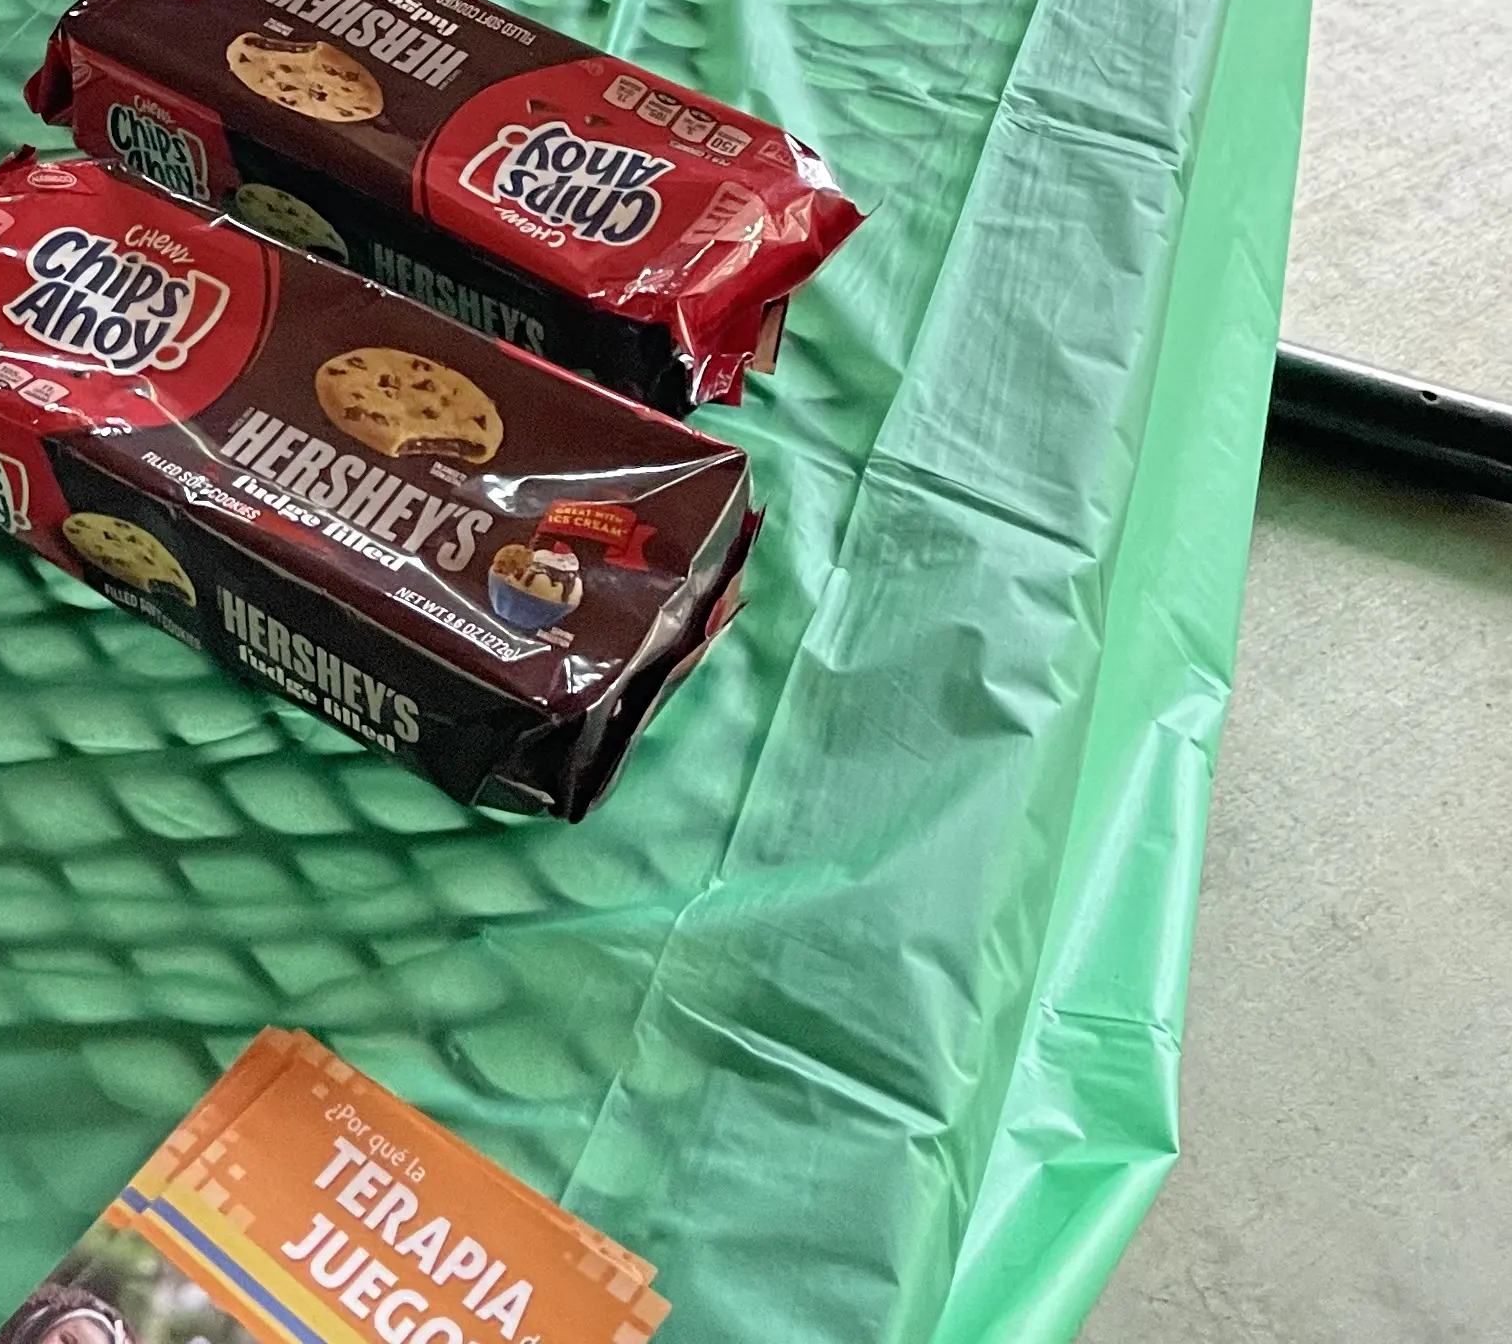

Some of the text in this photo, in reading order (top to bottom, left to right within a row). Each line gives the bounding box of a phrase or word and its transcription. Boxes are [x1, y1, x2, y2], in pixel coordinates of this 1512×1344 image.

[477, 10, 506, 30] SOFT
[501, 22, 536, 46] FILLED
[109, 105, 188, 164] Chips
[712, 136, 739, 154] 150
[498, 168, 658, 244] Chips
[30, 229, 193, 319] Chips
[373, 241, 544, 356] HERSHEY'S
[141, 451, 262, 521] FILLED SOFT COOKIES
[220, 409, 494, 572] HERSHEY'S
[231, 474, 414, 573] fudge filled
[548, 514, 574, 525] ICE
[396, 586, 426, 608] NET
[423, 599, 448, 619] WT
[443, 611, 465, 630] 9.6
[462, 621, 486, 640] OZ
[481, 631, 522, 660] (272g)
[223, 588, 421, 744] HERSHEY'S
[238, 644, 397, 754] fudge filled
[324, 1103, 426, 1184] ¿Por qué la
[280, 1212, 485, 1344] JUEGO
[313, 1135, 534, 1342] TERAPIA
